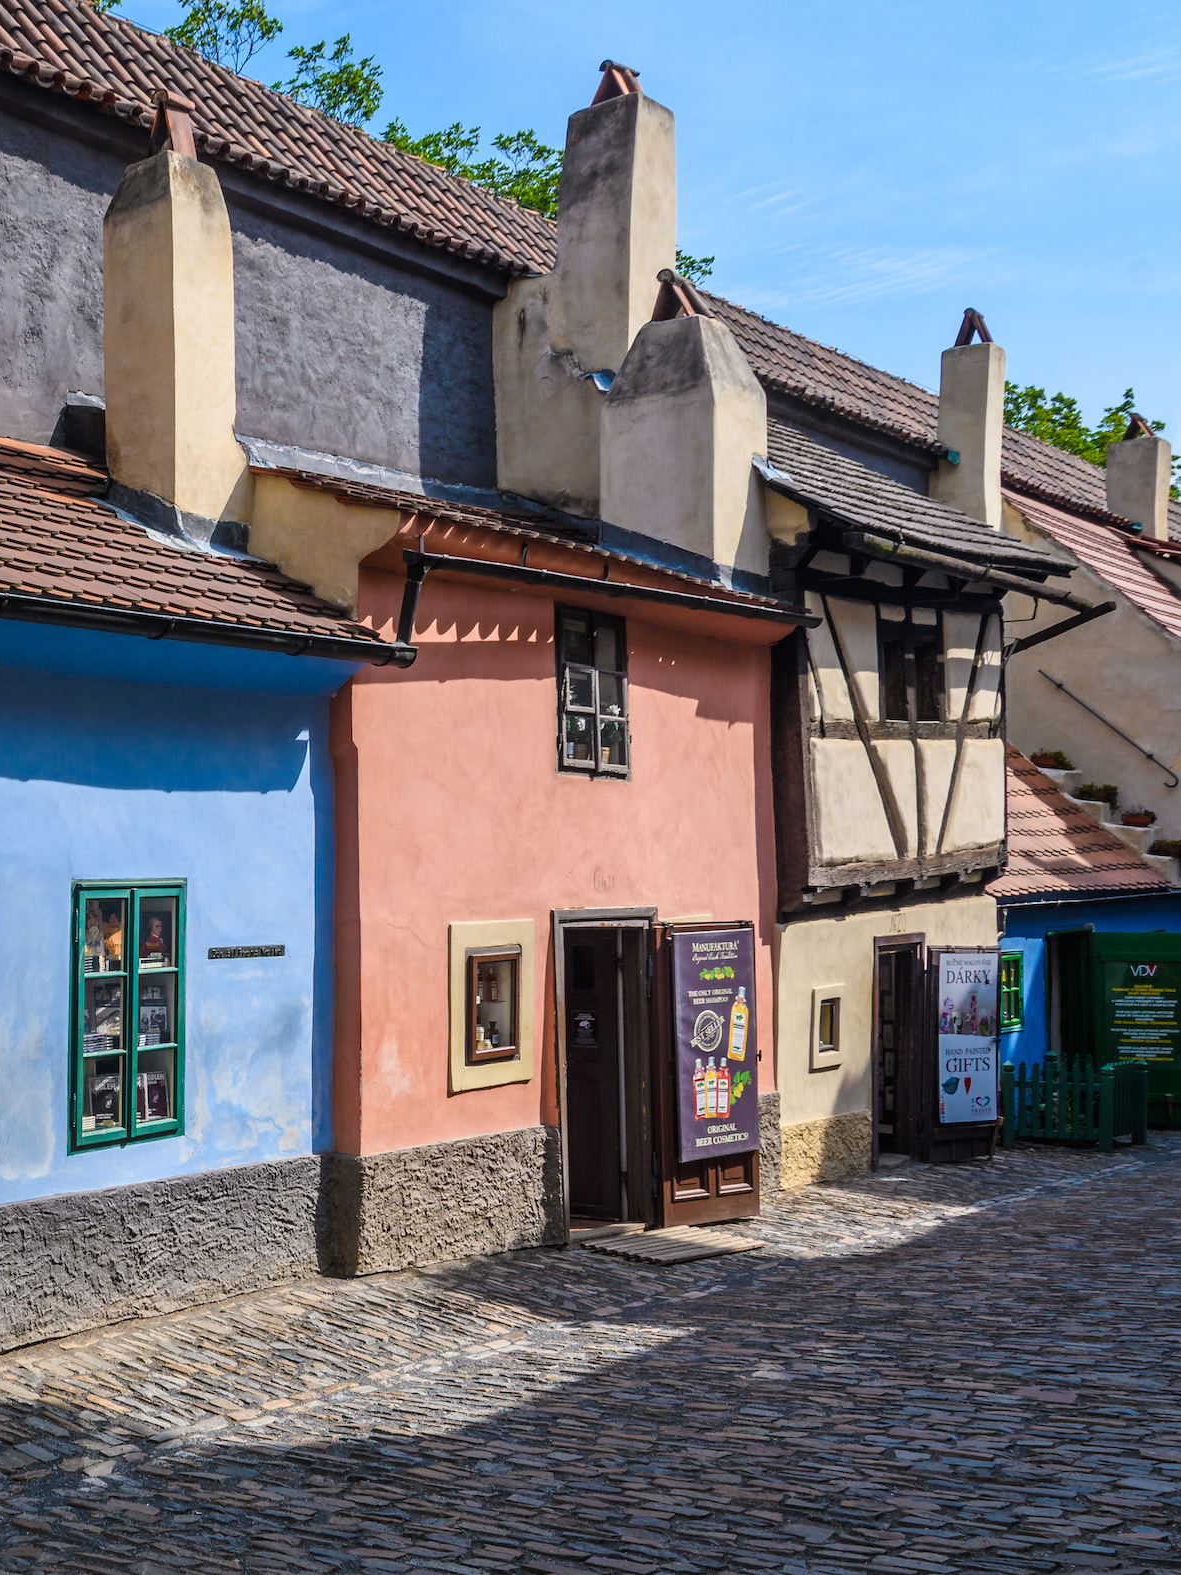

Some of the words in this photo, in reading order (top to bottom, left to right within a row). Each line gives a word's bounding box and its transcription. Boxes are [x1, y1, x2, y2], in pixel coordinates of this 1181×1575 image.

[946, 966, 991, 984] DÁRKY
[1129, 964, 1158, 977] VDV
[698, 989, 711, 997] ONLY
[690, 1031, 705, 1048] BEST
[704, 1015, 725, 1034] SELLER
[945, 1047, 963, 1056] HAND
[965, 1047, 991, 1055] PAINTED
[946, 1057, 990, 1073] GIFTS
[707, 1122, 738, 1134] ORIGINAL
[695, 1136, 713, 1147] BEER
